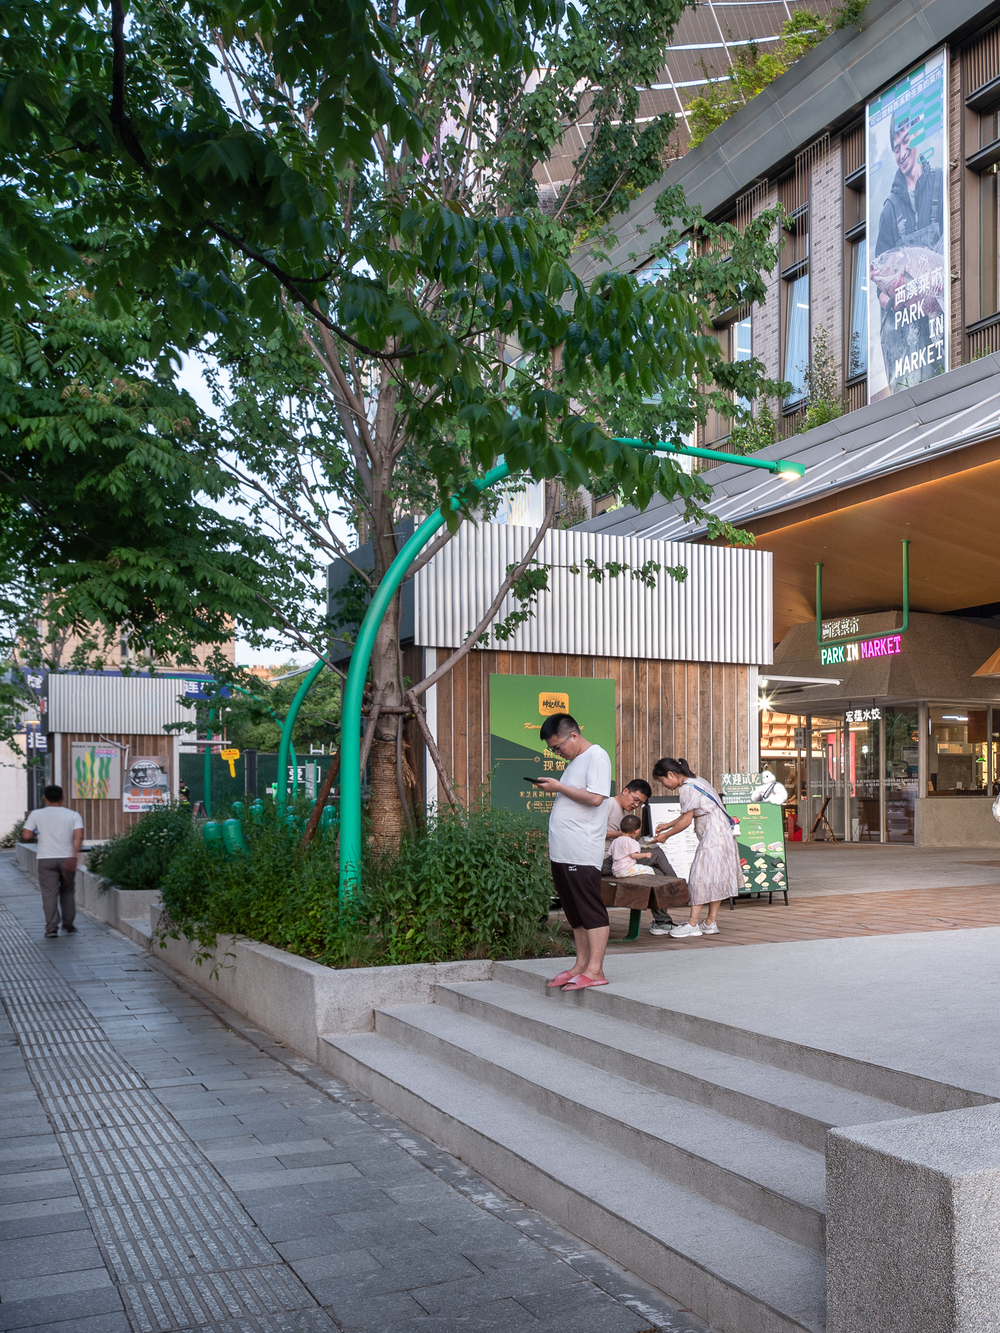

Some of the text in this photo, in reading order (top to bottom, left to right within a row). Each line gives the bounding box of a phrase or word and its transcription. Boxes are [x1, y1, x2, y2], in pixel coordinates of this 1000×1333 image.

[894, 266, 943, 307] 西溪菜市
[894, 298, 925, 331] PARK
[929, 314, 944, 339] IN
[895, 339, 944, 379] MARKET
[821, 634, 901, 665] PARK IN MARKET
[721, 773, 761, 785] 欢迎试吃
